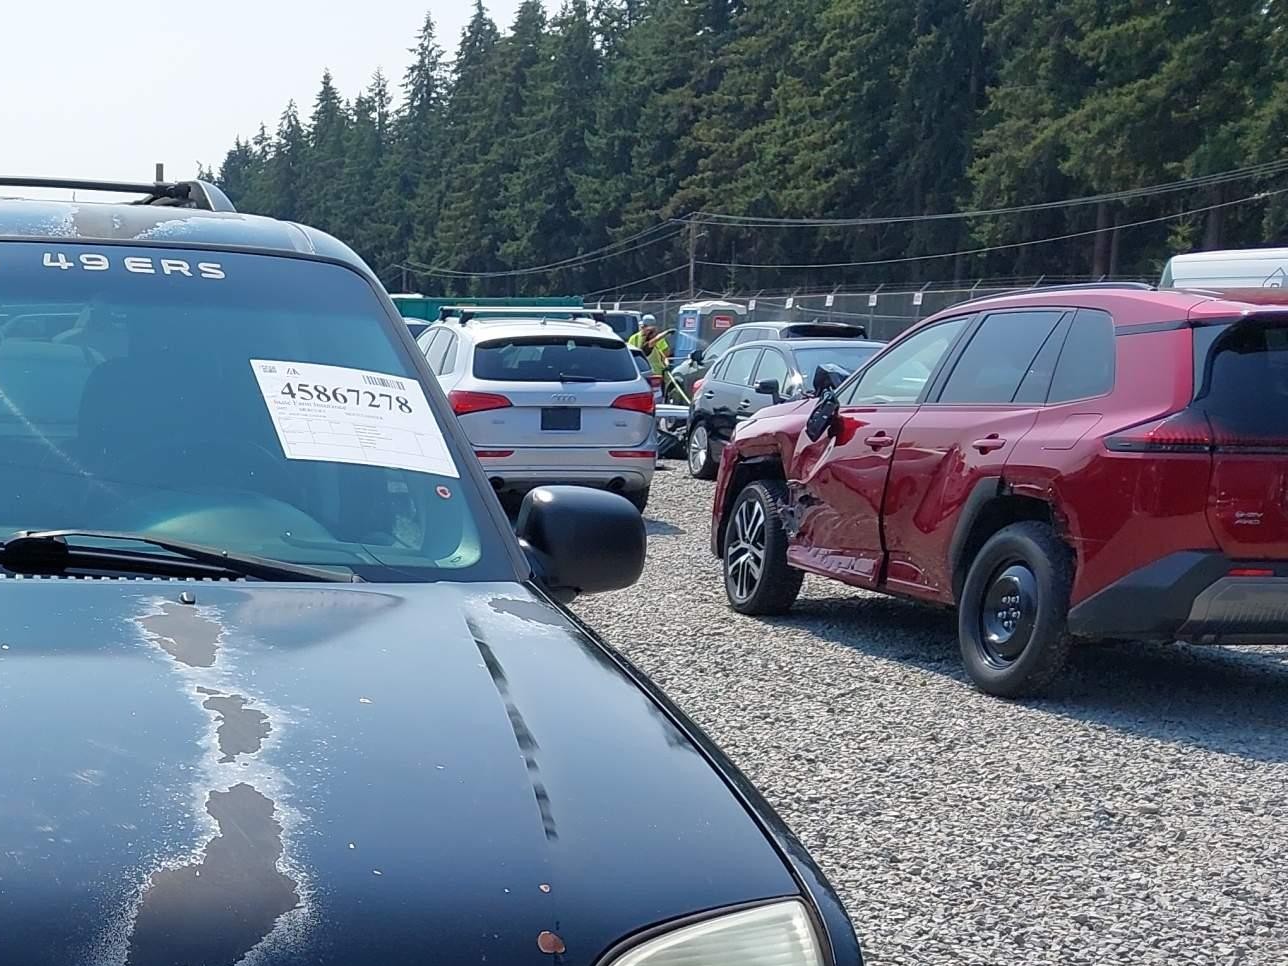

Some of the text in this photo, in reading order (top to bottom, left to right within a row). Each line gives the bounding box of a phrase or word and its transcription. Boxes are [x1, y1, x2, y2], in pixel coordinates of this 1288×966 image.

[42, 252, 226, 280] 49 ERS
[280, 381, 414, 415] 45867278
